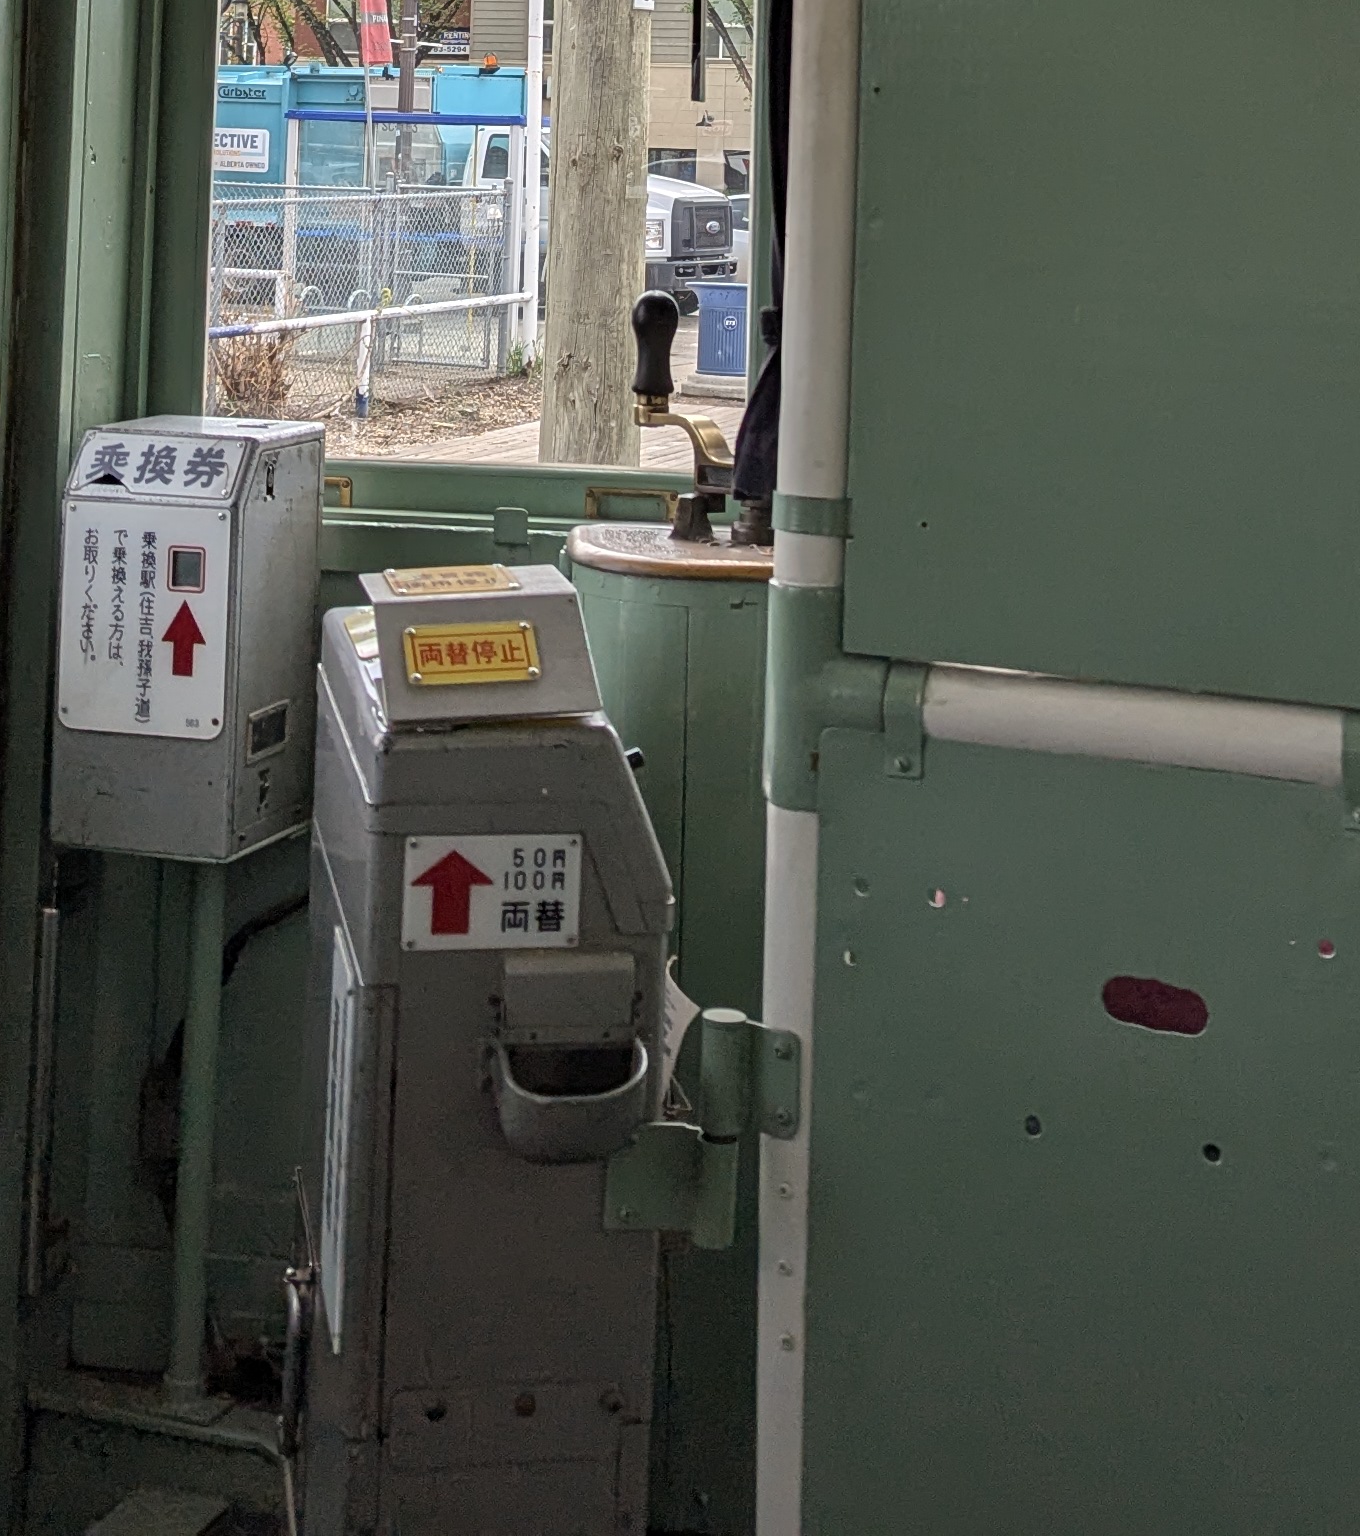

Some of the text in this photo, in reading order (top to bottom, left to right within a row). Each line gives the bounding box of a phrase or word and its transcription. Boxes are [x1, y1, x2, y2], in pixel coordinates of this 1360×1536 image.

[220, 160, 266, 169] ALBERTA OWNED
[85, 442, 228, 489] 乗換券
[417, 638, 526, 668] 両替停止
[512, 847, 566, 869] 50円
[503, 870, 566, 892] 100円
[500, 900, 566, 935] 両替
